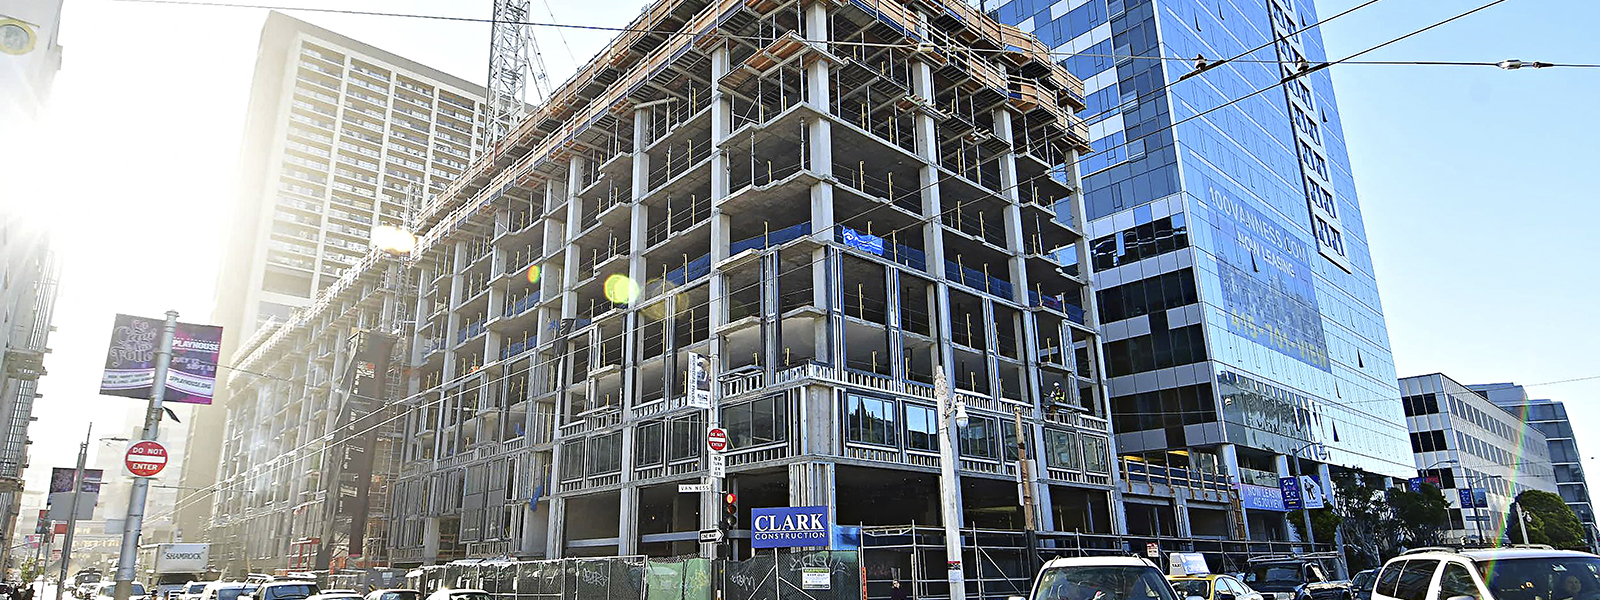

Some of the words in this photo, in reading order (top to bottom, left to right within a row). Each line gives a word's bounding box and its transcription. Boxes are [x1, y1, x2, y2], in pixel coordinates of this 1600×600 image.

[1208, 186, 1308, 263] 100VANNESS.COM
[1236, 230, 1261, 257] NOW
[1261, 246, 1297, 278] LEASING
[172, 339, 220, 351] PLAYHOUSE
[132, 463, 159, 471] ENTER
[754, 513, 825, 532] CLARK
[754, 532, 826, 540] CONSTRUCTION
[165, 552, 202, 560] SHAMROCK
